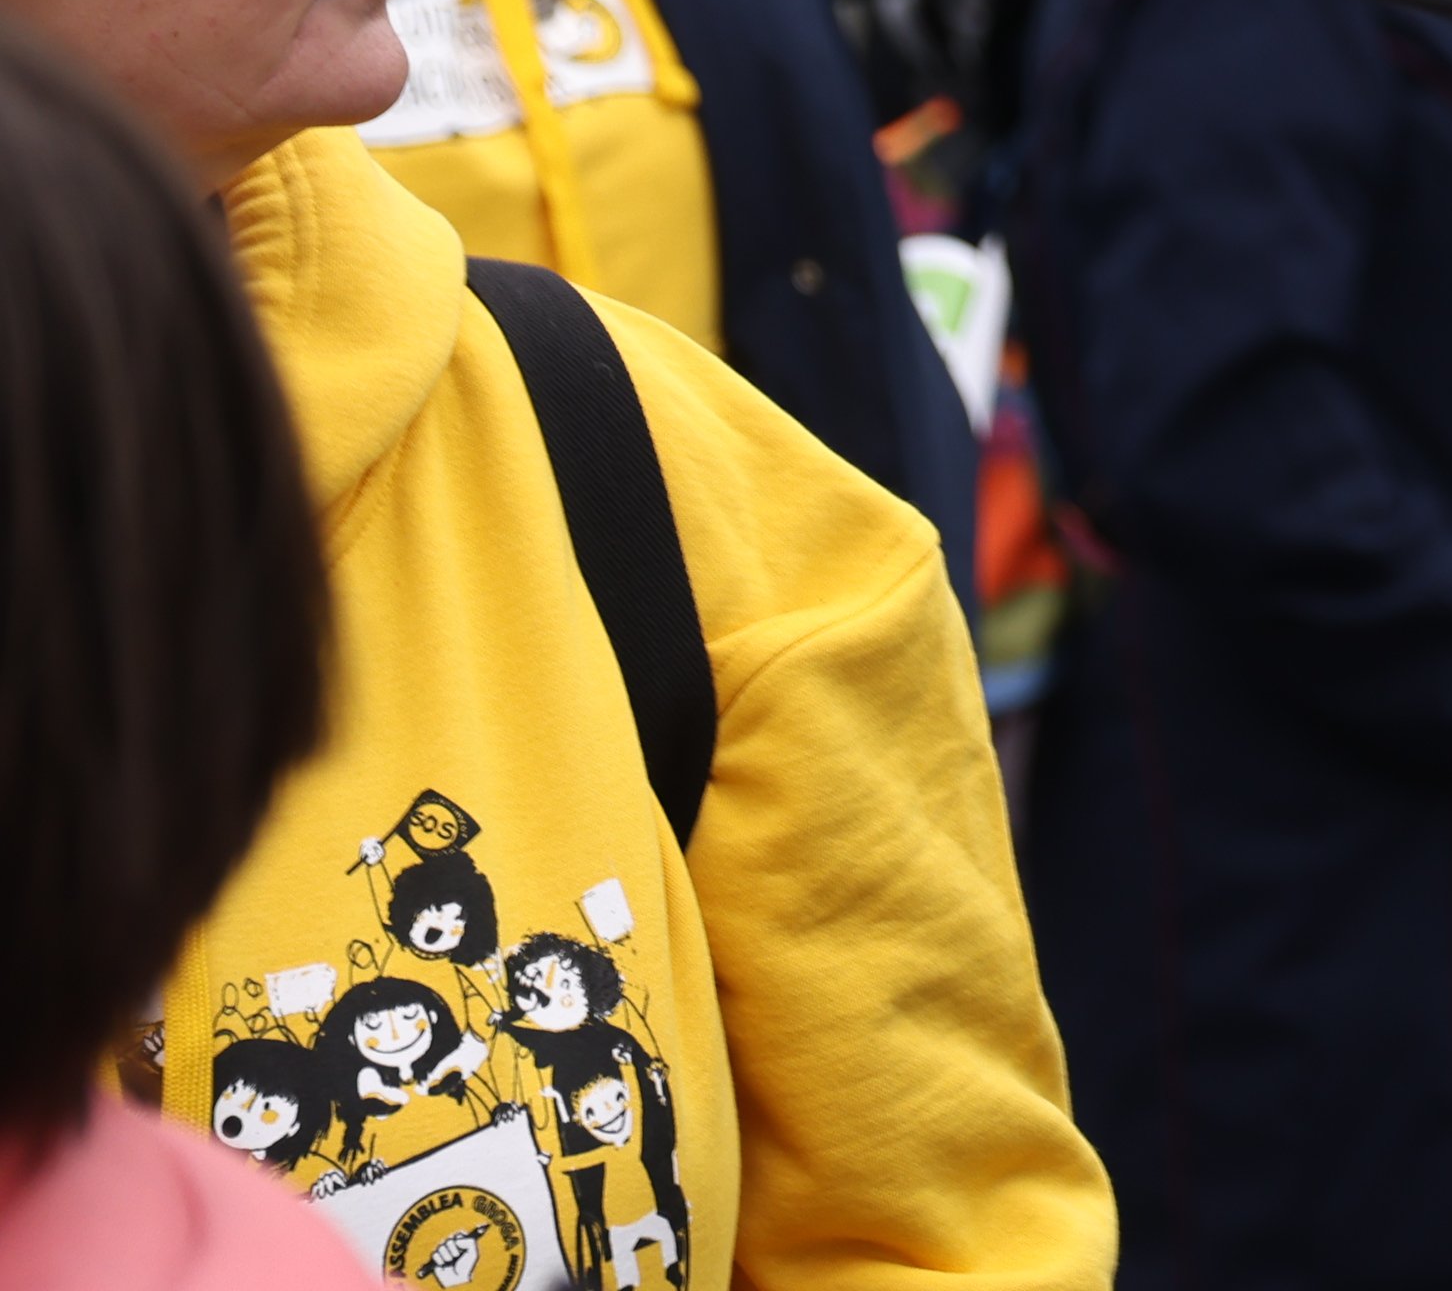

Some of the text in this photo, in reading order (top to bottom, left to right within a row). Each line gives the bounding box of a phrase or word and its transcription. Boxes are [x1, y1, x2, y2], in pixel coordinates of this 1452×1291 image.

[409, 811, 456, 839] SOS
[389, 1192, 464, 1278] ASSEMBLEA
[473, 1195, 520, 1252] GROGA
